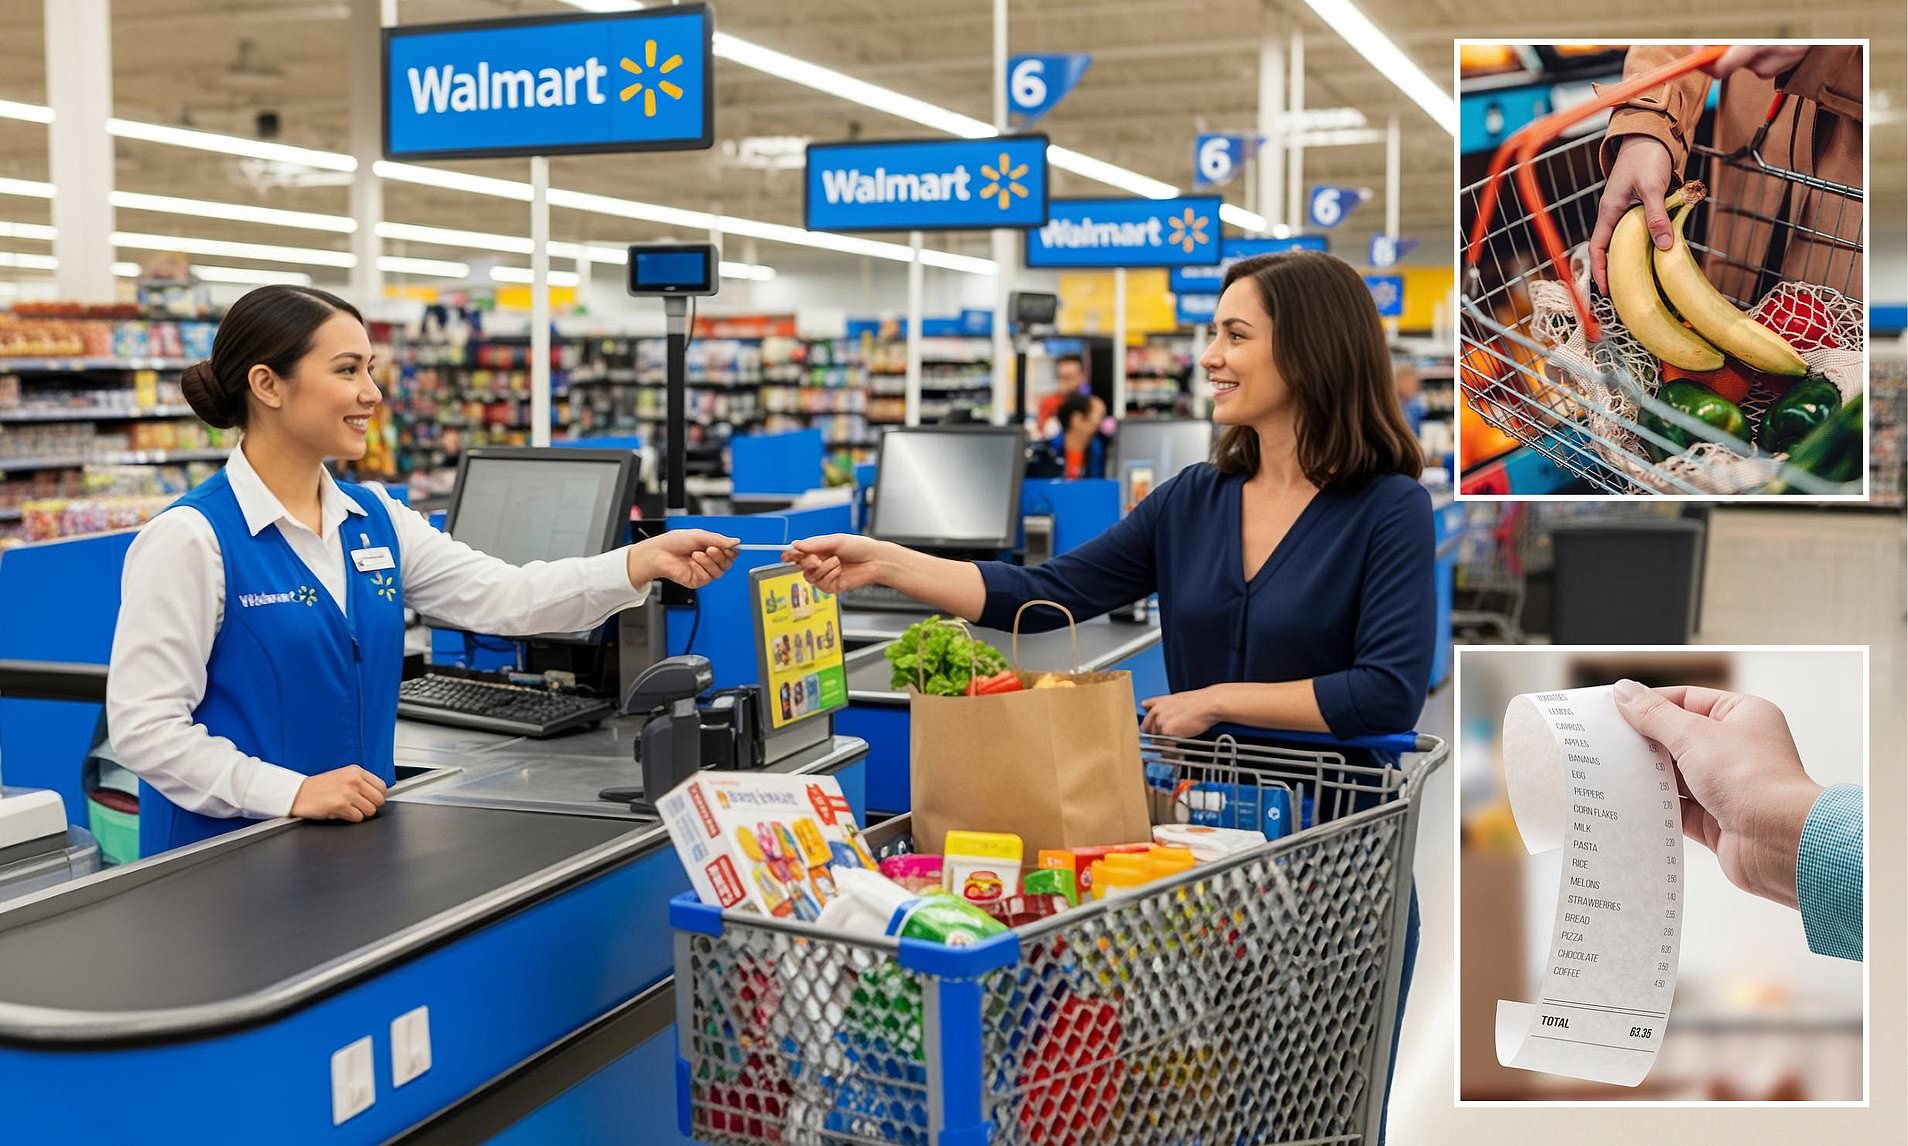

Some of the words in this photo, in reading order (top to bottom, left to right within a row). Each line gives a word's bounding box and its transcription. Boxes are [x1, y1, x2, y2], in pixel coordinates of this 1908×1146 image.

[407, 56, 608, 115] Walmart
[1010, 58, 1048, 108] 6
[1200, 137, 1232, 180] 6
[821, 164, 971, 204] Walmart
[1312, 187, 1342, 226] 6
[1038, 216, 1163, 249] Walmart
[1555, 722, 1586, 732] CARROTS
[1564, 737, 1590, 748] APPLES
[1568, 753, 1601, 766] BANANAS
[1571, 770, 1586, 780] EGG
[1574, 786, 1605, 800] PEPPERS
[1573, 804, 1593, 815] CORN
[1593, 807, 1618, 820] FLAKES
[1573, 822, 1592, 833] MILK
[1573, 840, 1598, 852] PASTA
[1572, 858, 1589, 869] RICE
[1570, 876, 1600, 889] MELONS
[1567, 894, 1622, 912] STRAWBERRIES
[1564, 913, 1591, 925] BREAD
[1561, 931, 1584, 943] PIZZA
[1557, 949, 1599, 963] CHOCOLATE
[1553, 967, 1582, 979] COFFEE
[1541, 1015, 1570, 1029] TOTAL
[1629, 1026, 1653, 1039] 63.35
